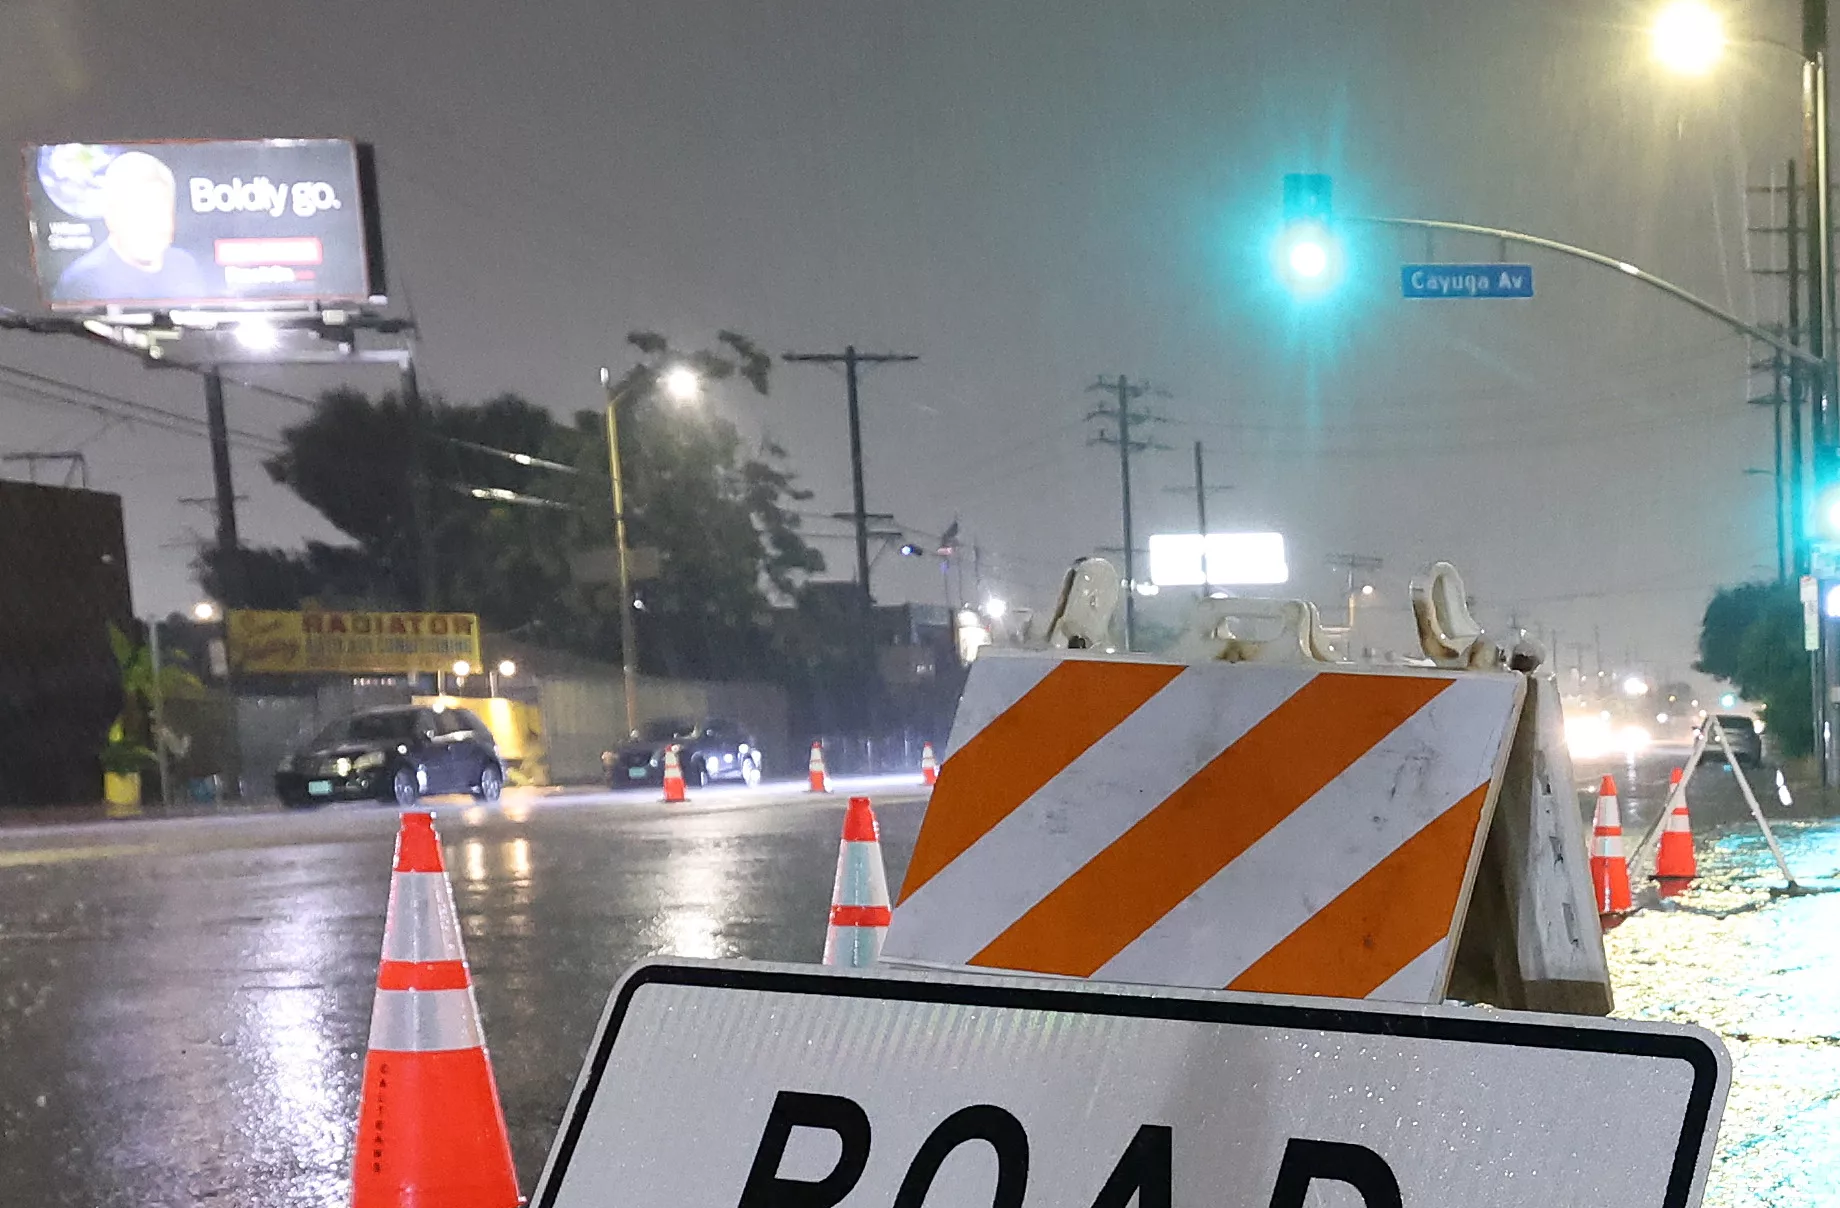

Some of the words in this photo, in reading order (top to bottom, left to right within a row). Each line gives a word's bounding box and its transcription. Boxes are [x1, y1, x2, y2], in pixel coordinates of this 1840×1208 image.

[189, 176, 288, 217] Boldly
[291, 181, 341, 217] go.
[1411, 271, 1488, 295] Cayuga
[1499, 271, 1523, 290] Av
[303, 613, 473, 635] RADIATOR
